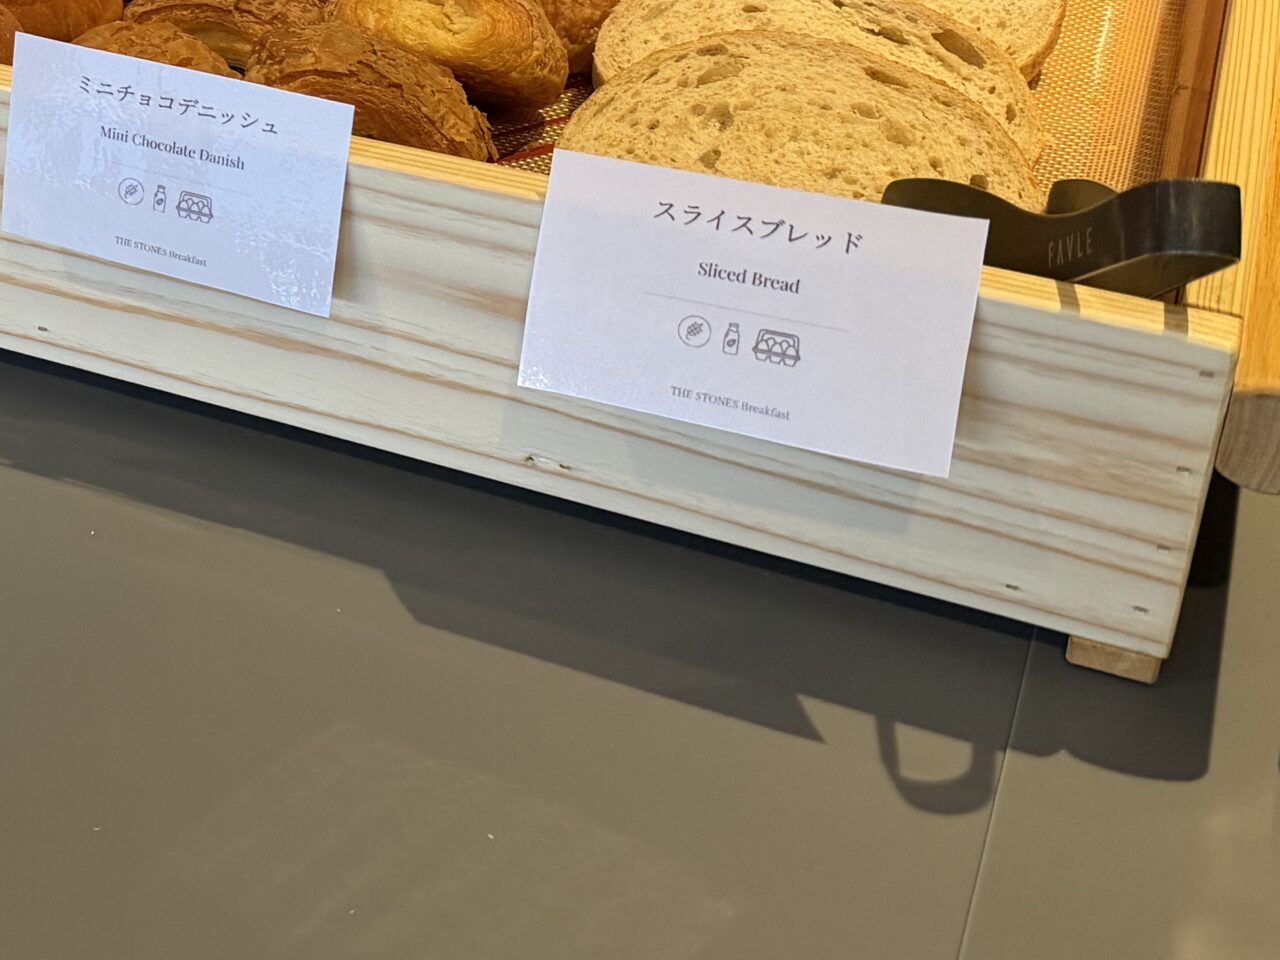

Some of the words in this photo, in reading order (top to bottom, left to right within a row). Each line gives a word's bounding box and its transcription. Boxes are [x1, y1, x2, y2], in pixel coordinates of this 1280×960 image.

[78, 75, 280, 136] ミニチョコデニッシュ
[100, 125, 129, 143] Mini
[132, 132, 197, 160] Chocolate
[199, 147, 246, 171] Danish
[653, 199, 864, 255] スライスブレッド
[114, 235, 132, 248] THE
[133, 240, 168, 257] STONES
[169, 249, 208, 268] Breakfast
[697, 261, 747, 285] Sliced
[751, 270, 802, 295] Bread
[670, 385, 694, 400] THE
[695, 391, 739, 410] STONES
[740, 400, 791, 421] Breakfast
